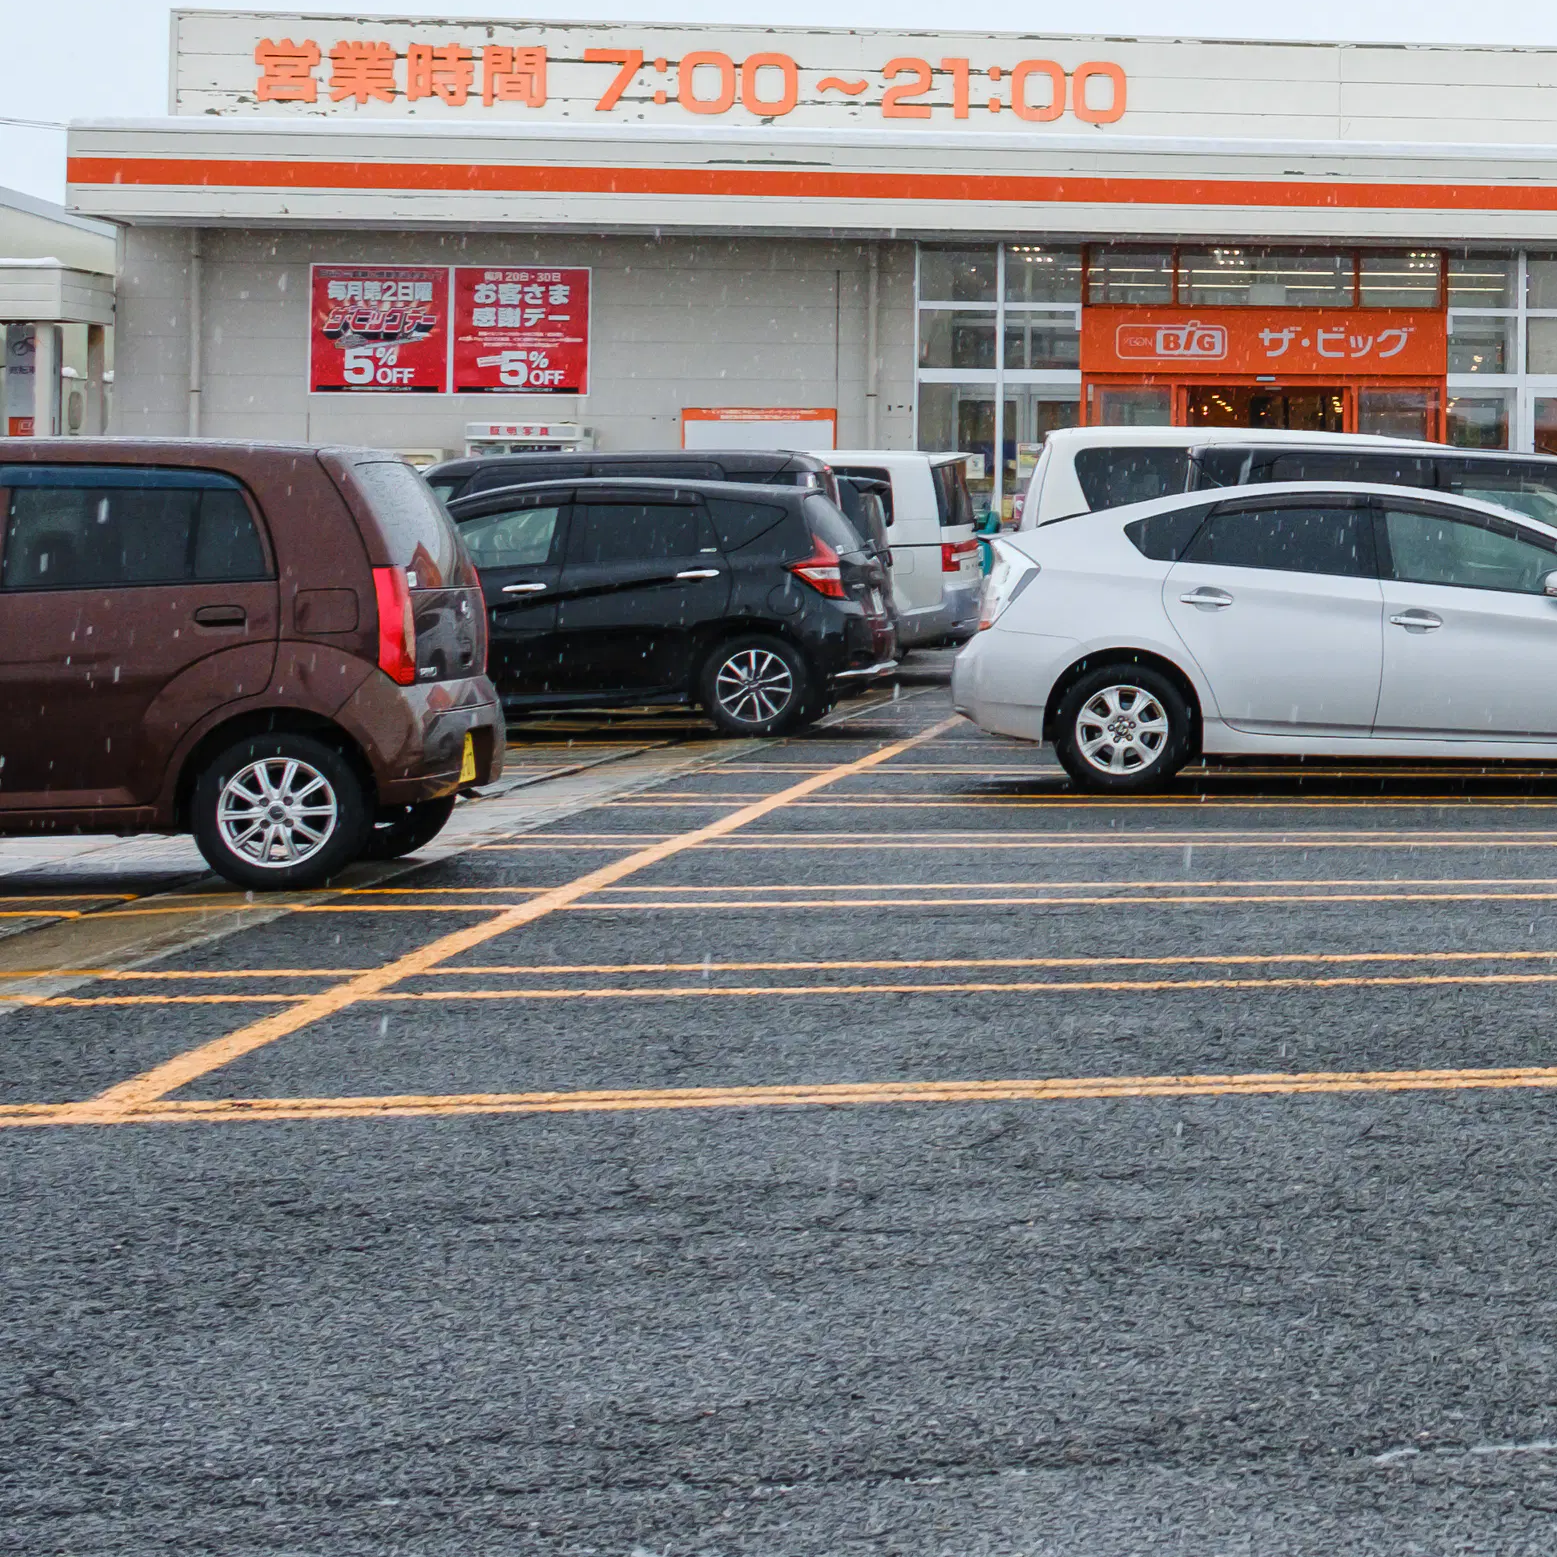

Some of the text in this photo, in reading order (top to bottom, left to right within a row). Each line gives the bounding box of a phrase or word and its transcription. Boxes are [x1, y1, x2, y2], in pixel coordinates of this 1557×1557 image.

[254, 39, 548, 109] 営業時間
[474, 284, 570, 305] お客さま
[473, 307, 570, 327] 感謝デー
[1258, 326, 1417, 358] ザ・ビッグ
[343, 347, 415, 384] 5% OFF
[500, 351, 549, 385] 5%
[530, 370, 565, 385] OFF
